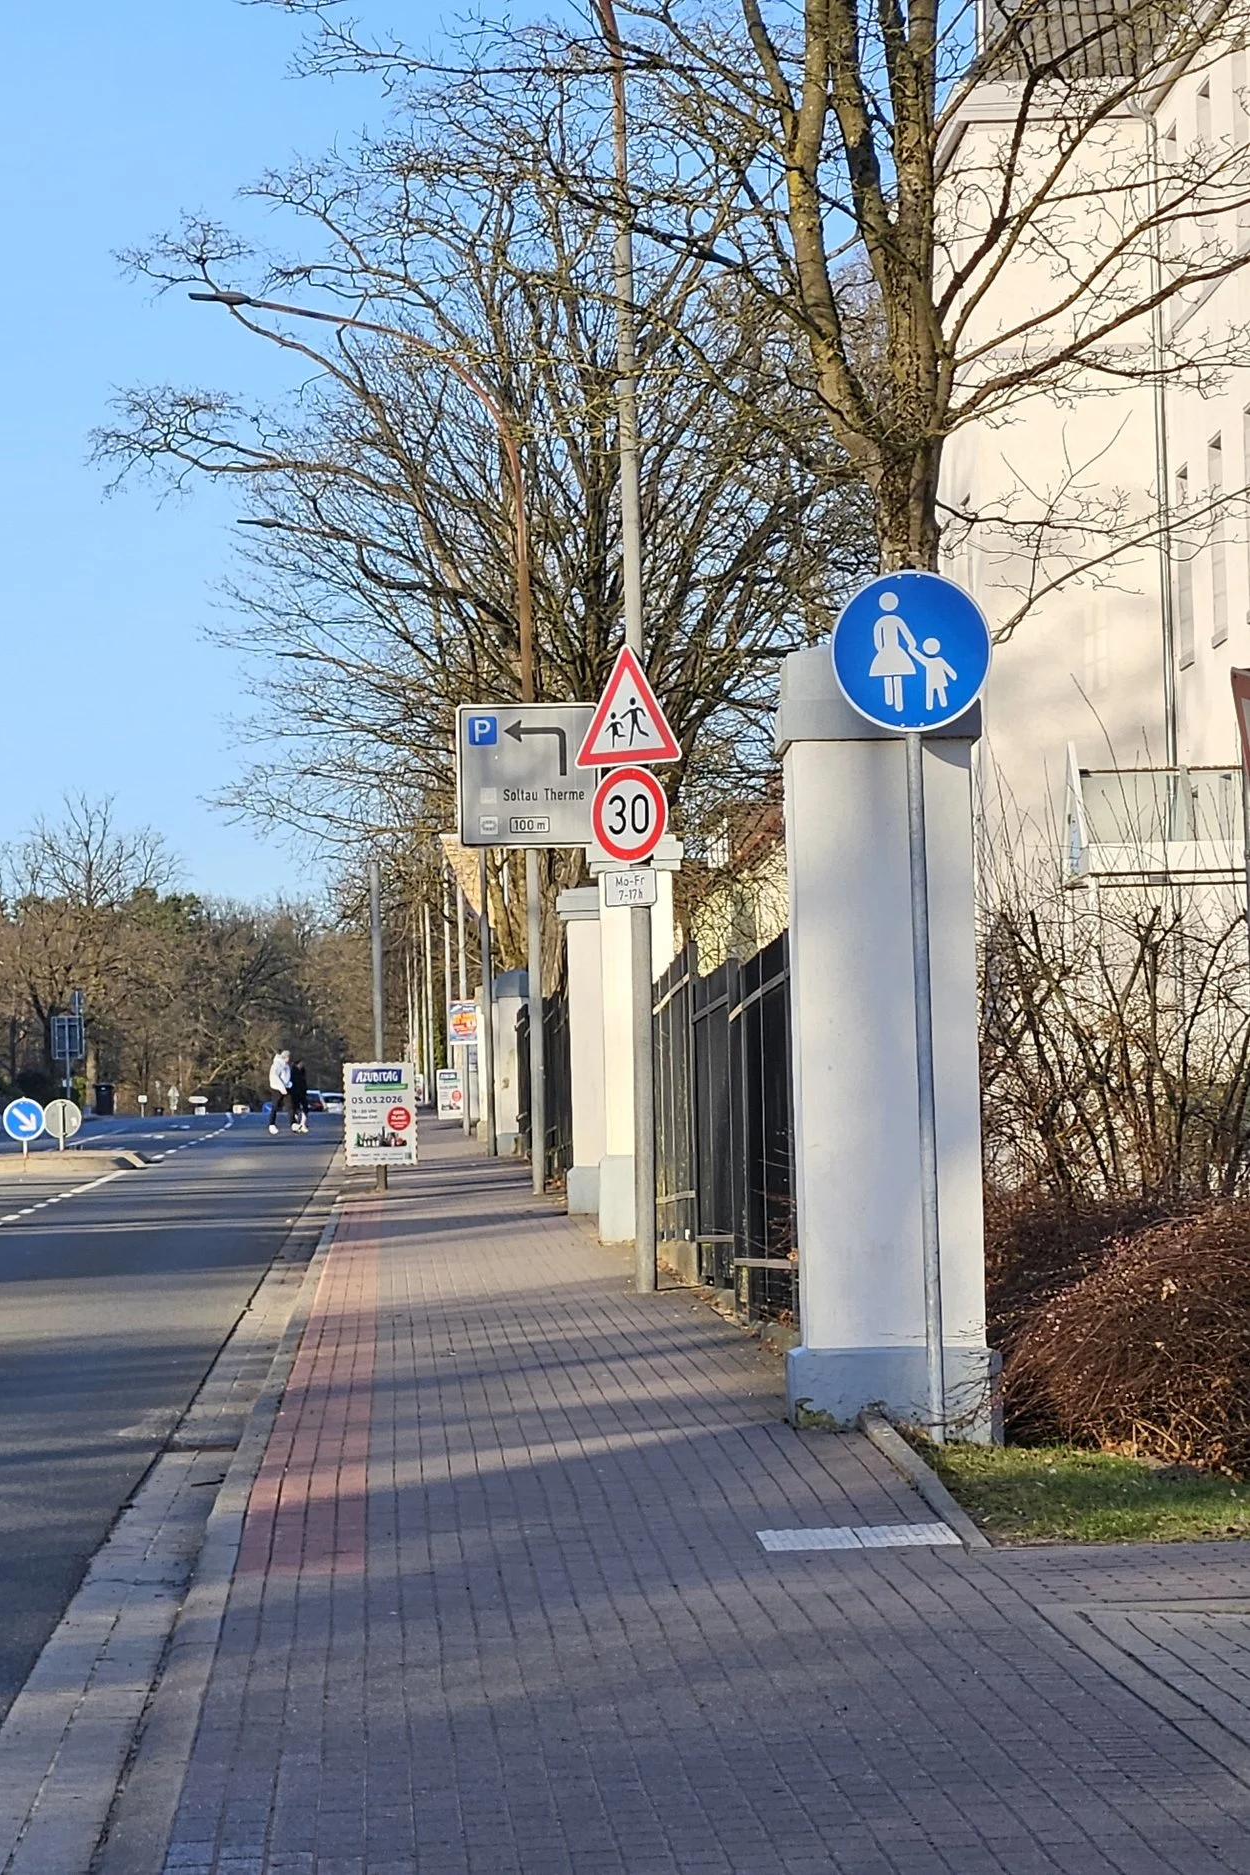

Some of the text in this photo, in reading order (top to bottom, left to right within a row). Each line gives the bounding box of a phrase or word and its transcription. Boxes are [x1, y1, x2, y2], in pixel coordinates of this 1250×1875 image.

[474, 719, 491, 742] P
[502, 787, 585, 802] Soltau Therme
[607, 793, 650, 836] 30
[514, 819, 546, 831] 100 m
[615, 874, 645, 887] Mo-Fr
[355, 1070, 399, 1083] AZUBITAG
[351, 1095, 403, 1104] 05.03.2026
